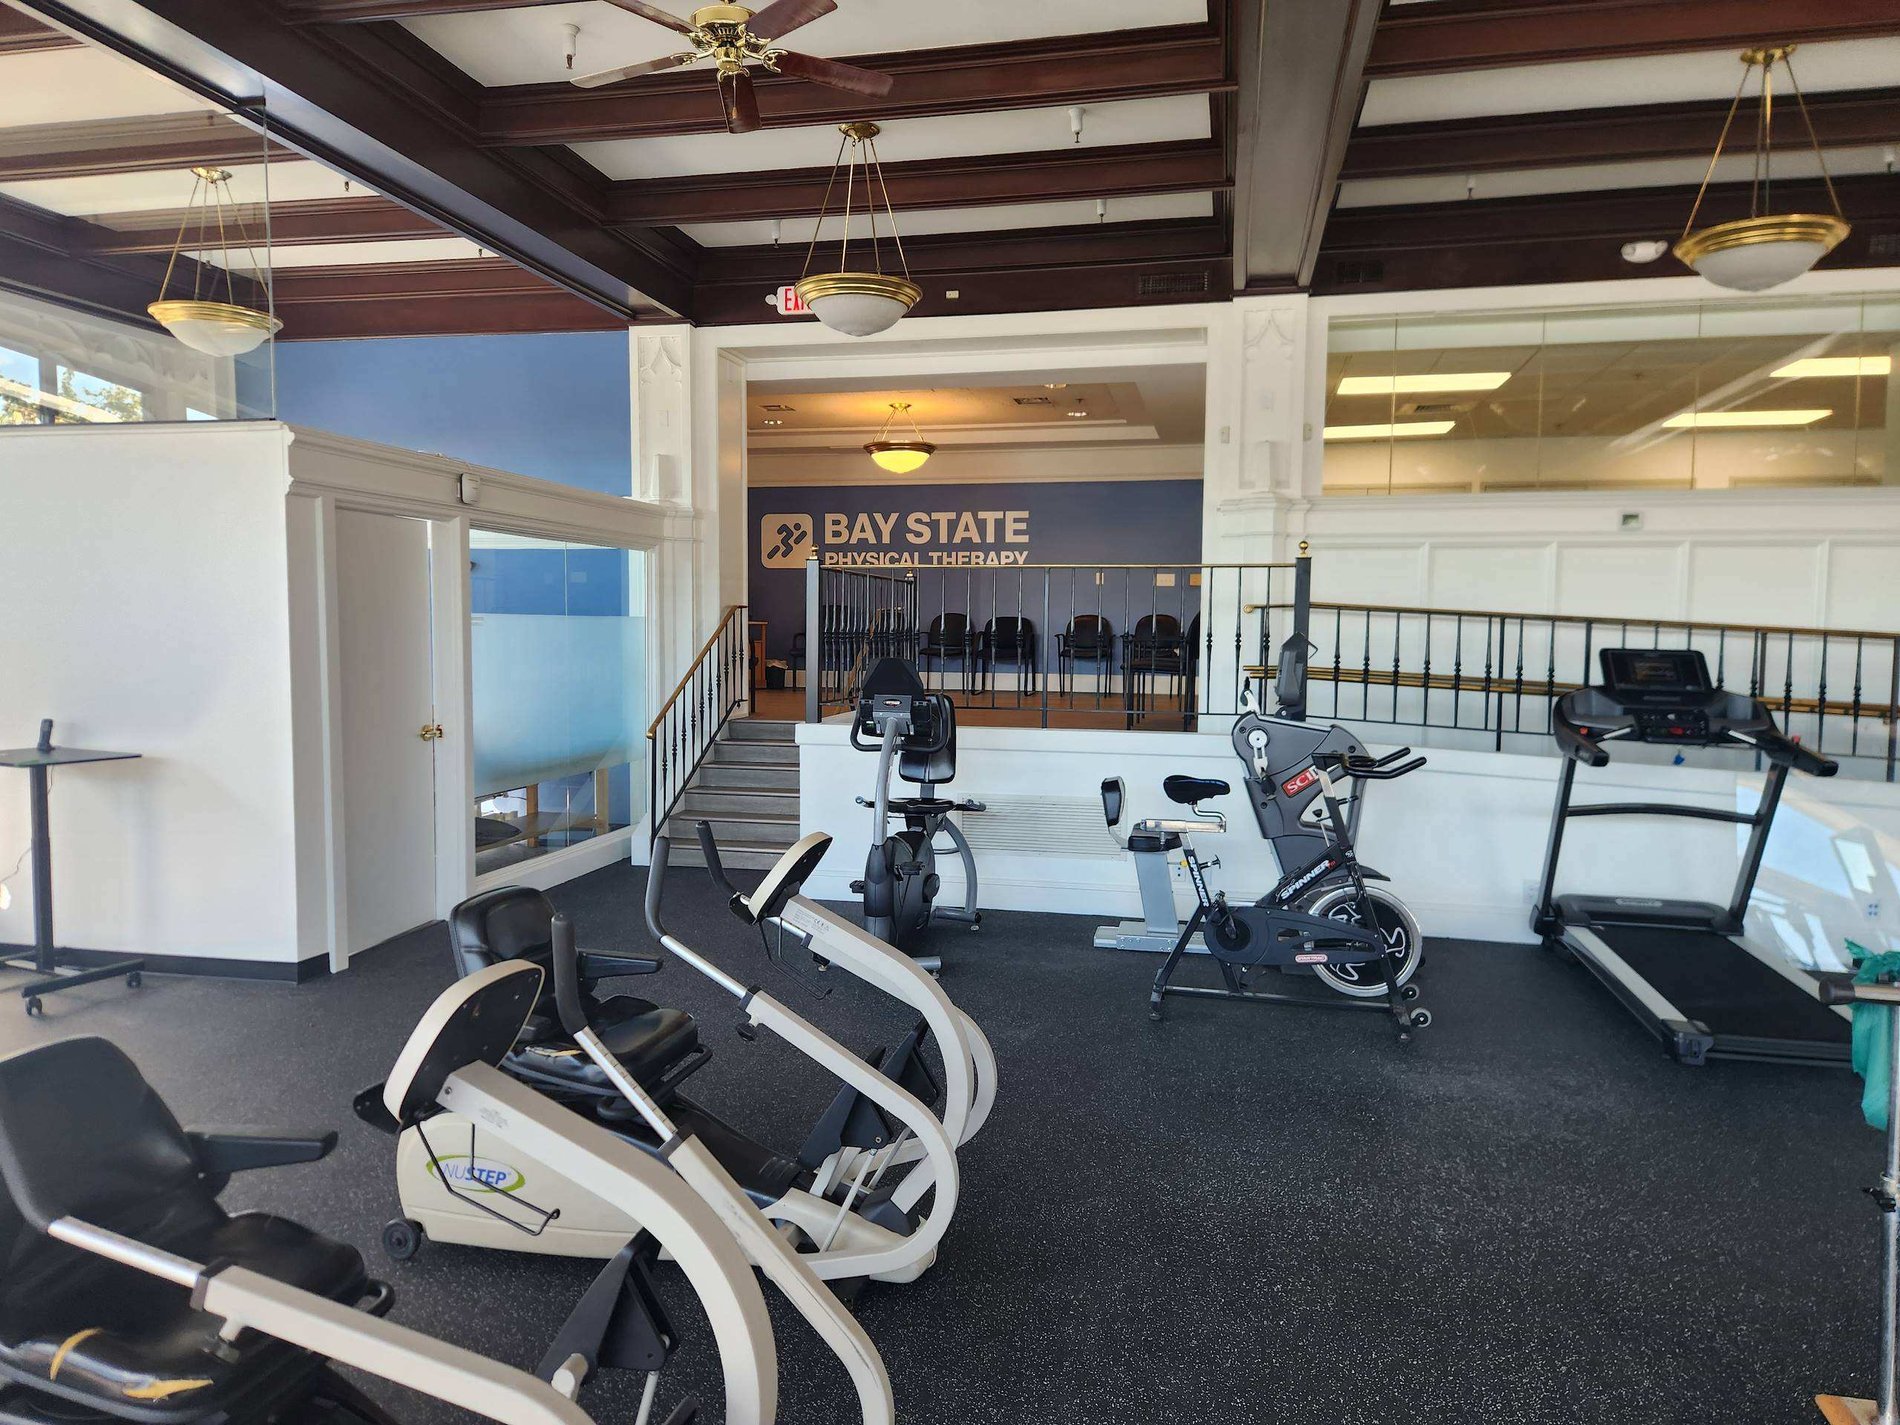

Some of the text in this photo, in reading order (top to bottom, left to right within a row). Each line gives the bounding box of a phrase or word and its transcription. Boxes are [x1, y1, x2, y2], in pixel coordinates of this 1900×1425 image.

[785, 288, 808, 311] EX
[824, 510, 1030, 545] BAY STATE
[1187, 855, 1210, 907] SPINNER
[1280, 859, 1330, 900] SPINNER
